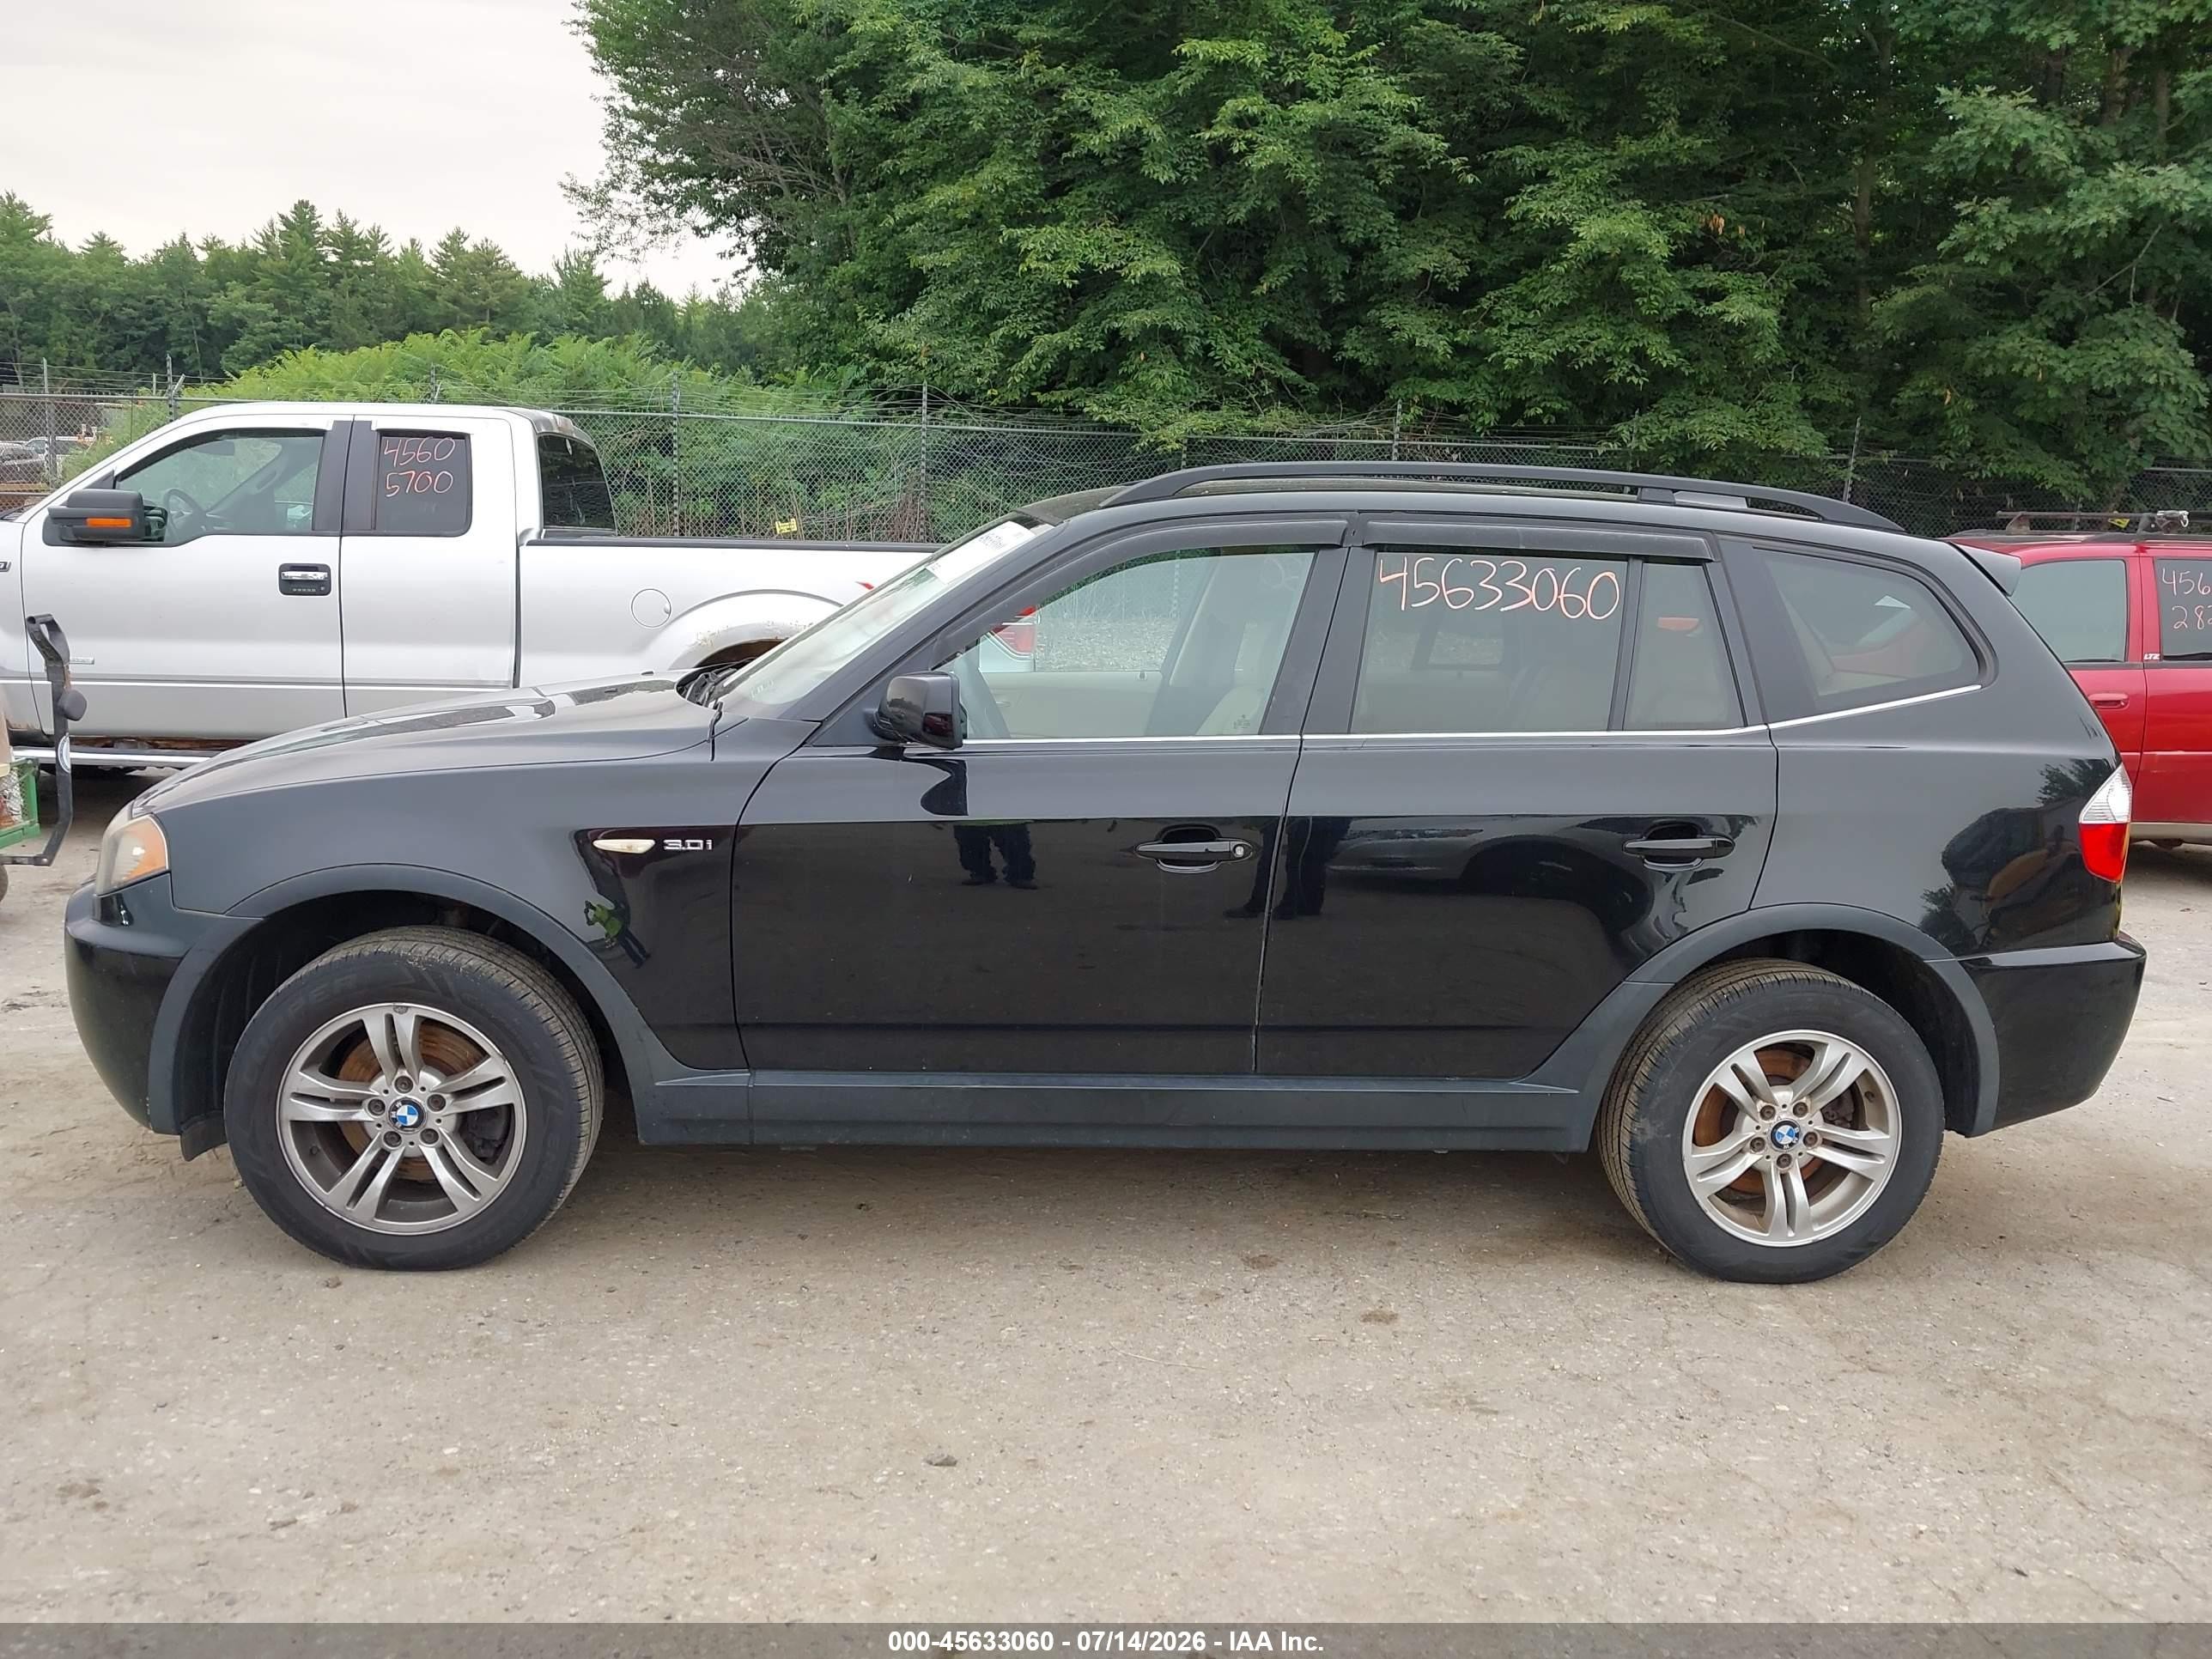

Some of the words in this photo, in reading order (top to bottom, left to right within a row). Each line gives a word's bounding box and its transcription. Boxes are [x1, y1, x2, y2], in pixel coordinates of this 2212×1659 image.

[384, 436, 456, 467] 4560
[386, 471, 453, 497] 5700
[1379, 556, 1620, 620] 45633060
[2162, 568, 2211, 596] 456
[663, 839, 713, 850] 3.0i
